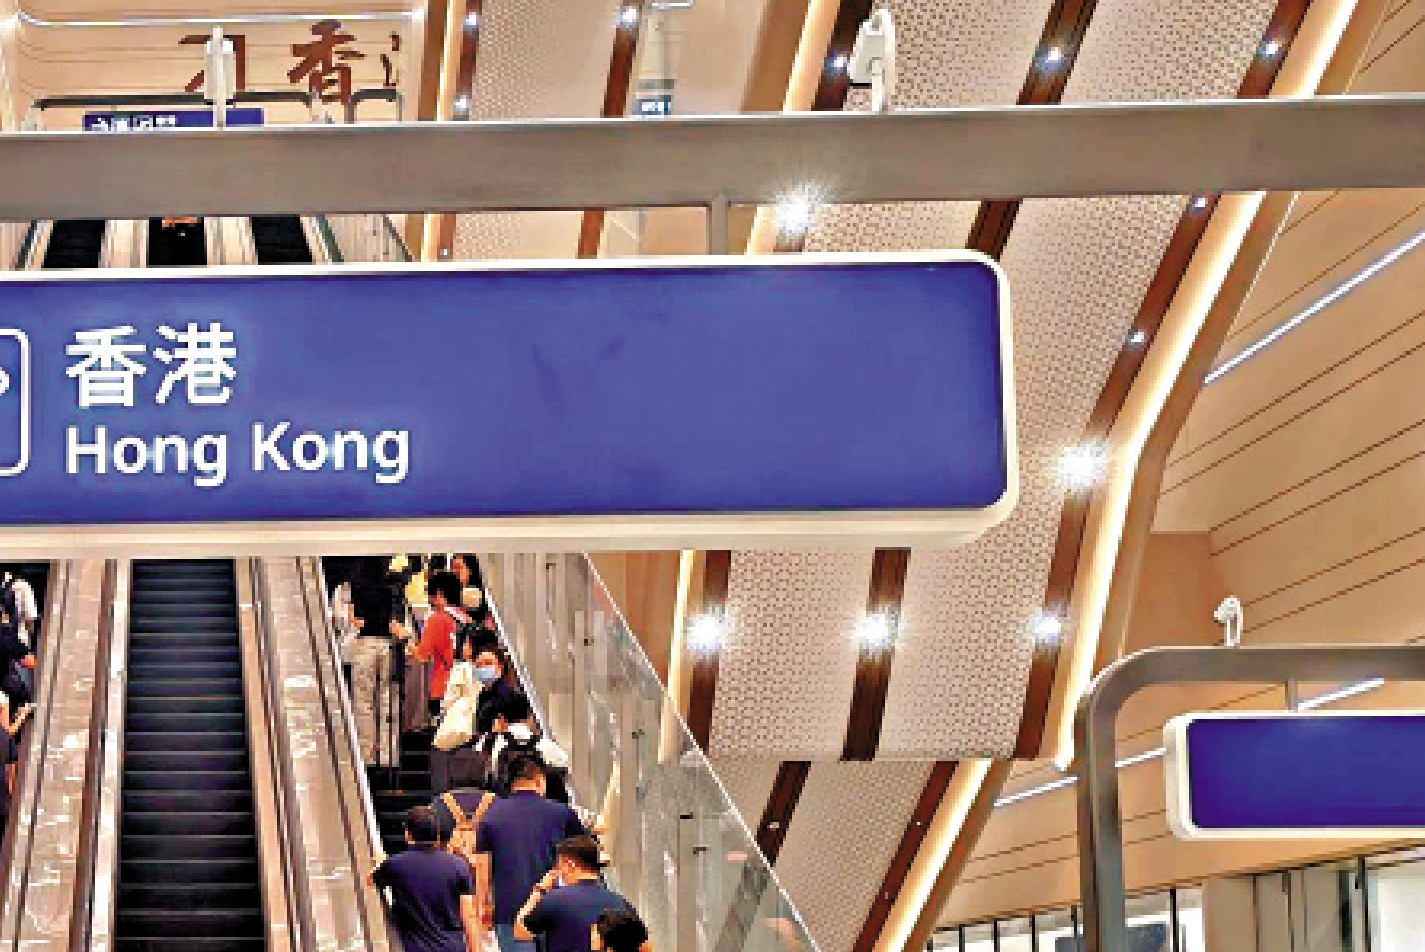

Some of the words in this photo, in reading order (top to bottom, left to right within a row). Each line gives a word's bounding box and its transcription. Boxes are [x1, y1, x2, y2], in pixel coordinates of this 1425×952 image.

[65, 322, 237, 409] 香港
[66, 426, 227, 487] Hong
[254, 421, 410, 485] Kong
